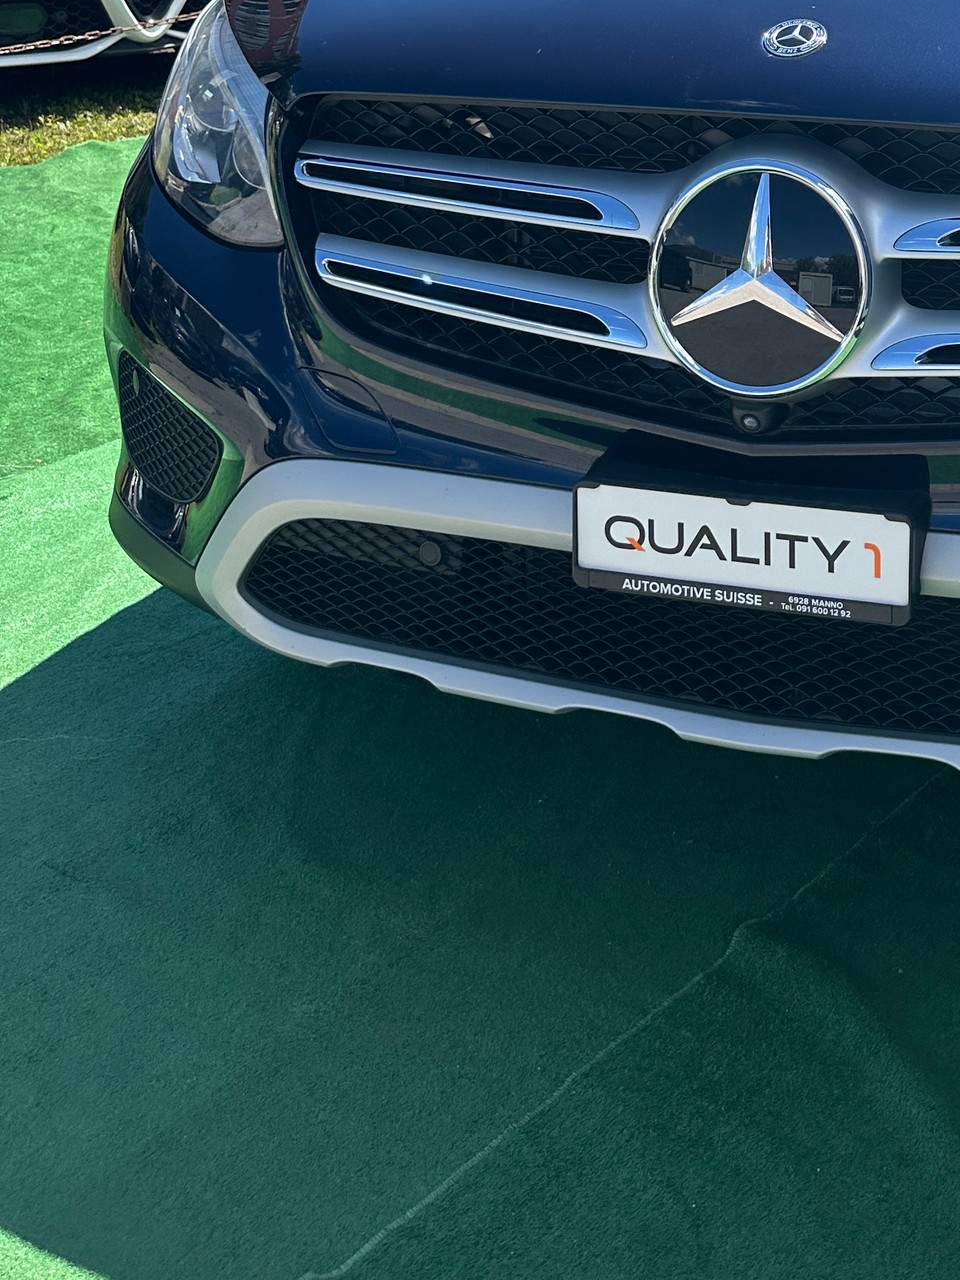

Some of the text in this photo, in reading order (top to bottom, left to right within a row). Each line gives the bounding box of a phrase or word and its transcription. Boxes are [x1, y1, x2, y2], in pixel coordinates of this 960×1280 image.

[604, 515, 881, 578] QUALITY 1
[622, 578, 712, 600] AUTOMOTIVE
[714, 590, 762, 606] SUISSE
[788, 596, 844, 609] 6928 MANNO
[796, 604, 811, 613] 091
[812, 606, 828, 615] 600
[830, 608, 839, 617] 12
[840, 610, 851, 618] 92
